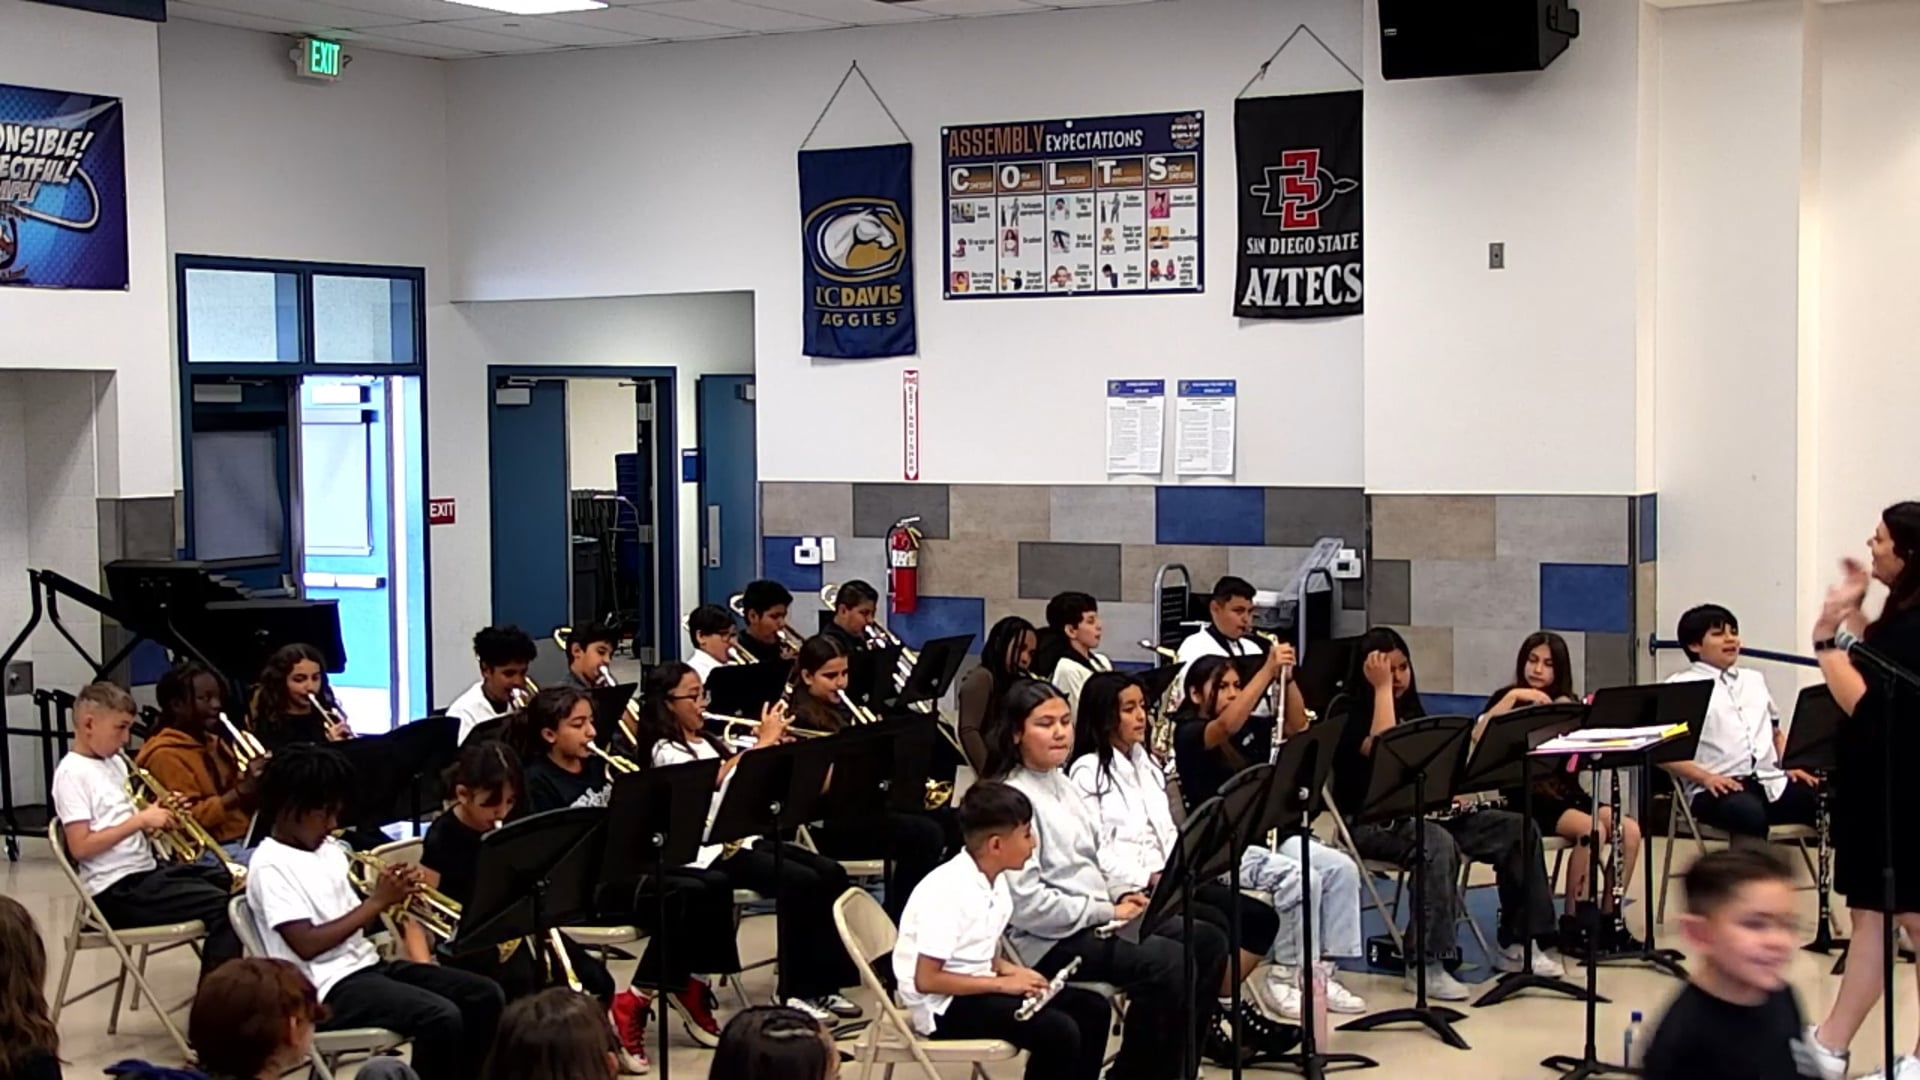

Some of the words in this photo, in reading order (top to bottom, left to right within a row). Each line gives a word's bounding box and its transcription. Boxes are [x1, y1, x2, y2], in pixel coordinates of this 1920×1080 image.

[311, 40, 341, 76] EXIT
[948, 124, 1044, 157] ASSEMBLY
[1045, 129, 1143, 153] EXPECTATIONS
[1246, 236, 1266, 254] SAN
[1269, 236, 1315, 254] DIEGO
[1317, 232, 1360, 252] STATE
[1241, 263, 1363, 306] AZTECS
[822, 312, 897, 327] AGGIES
[430, 503, 454, 517] EXIT
